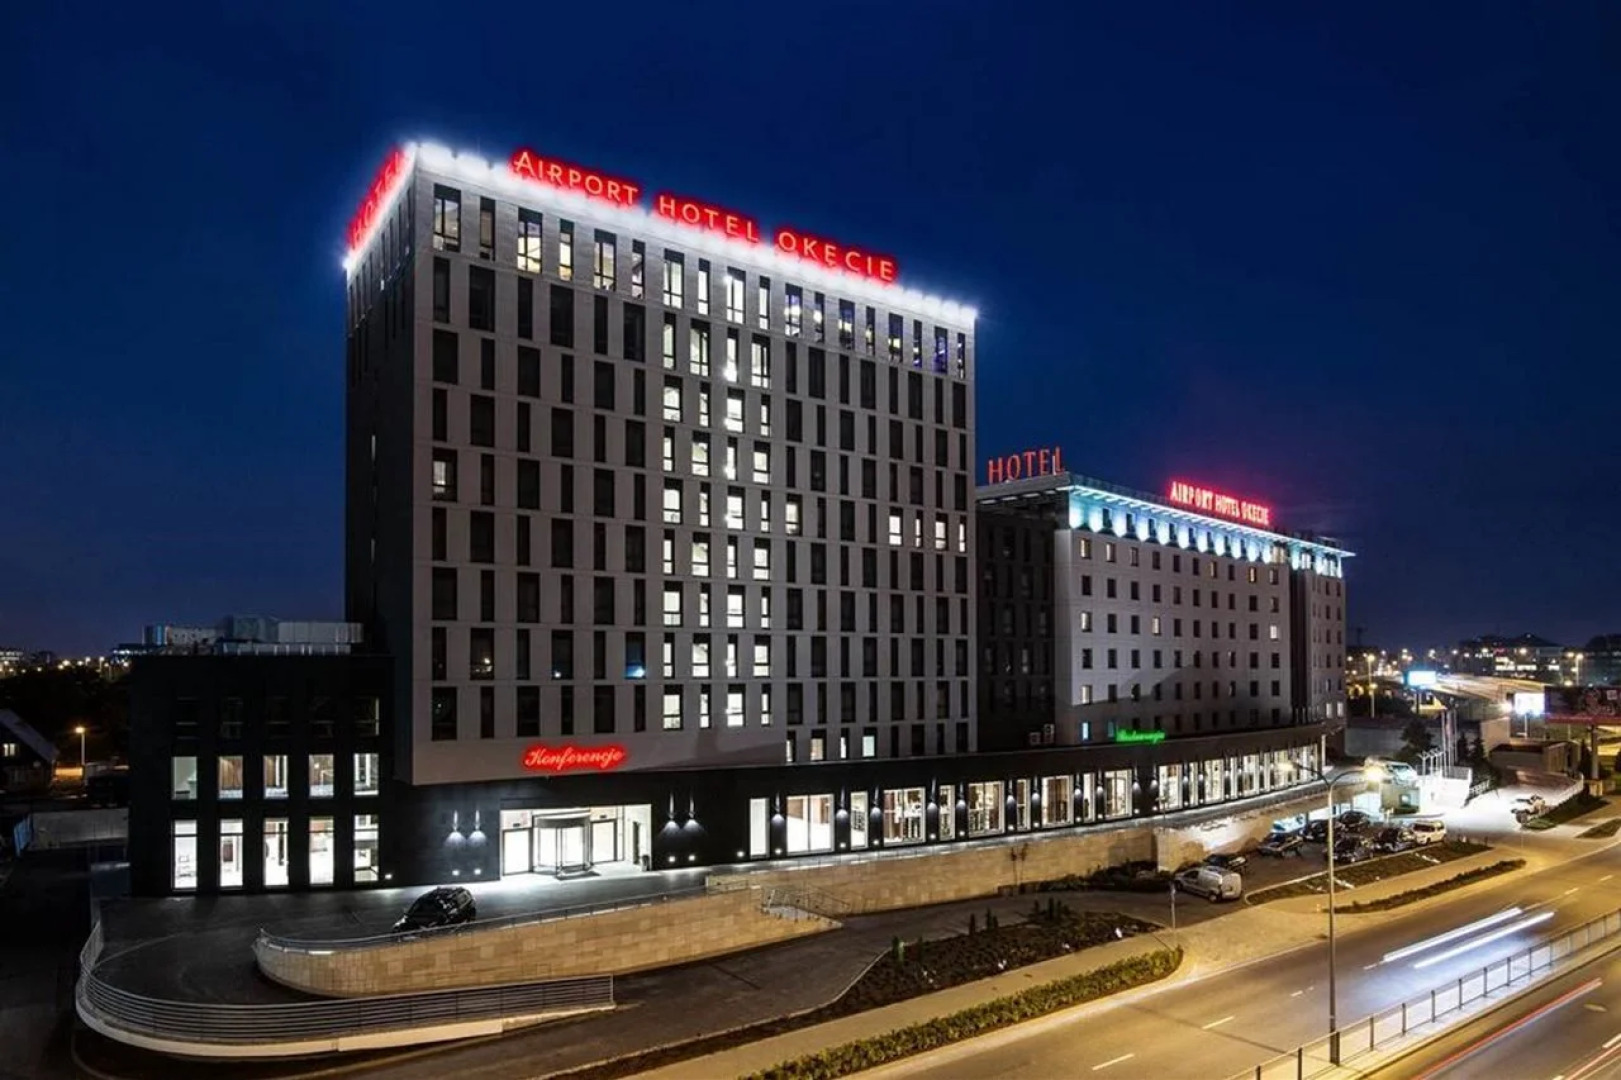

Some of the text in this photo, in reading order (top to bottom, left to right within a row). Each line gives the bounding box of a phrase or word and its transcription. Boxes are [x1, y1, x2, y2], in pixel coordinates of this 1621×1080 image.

[513, 151, 893, 282] AIRPORT HOTEL OKĘCIE
[988, 446, 1065, 485] HOTEL
[1169, 481, 1213, 511] AIRPORT
[1215, 493, 1240, 518] HOTEL
[524, 746, 623, 771] Konferencje
